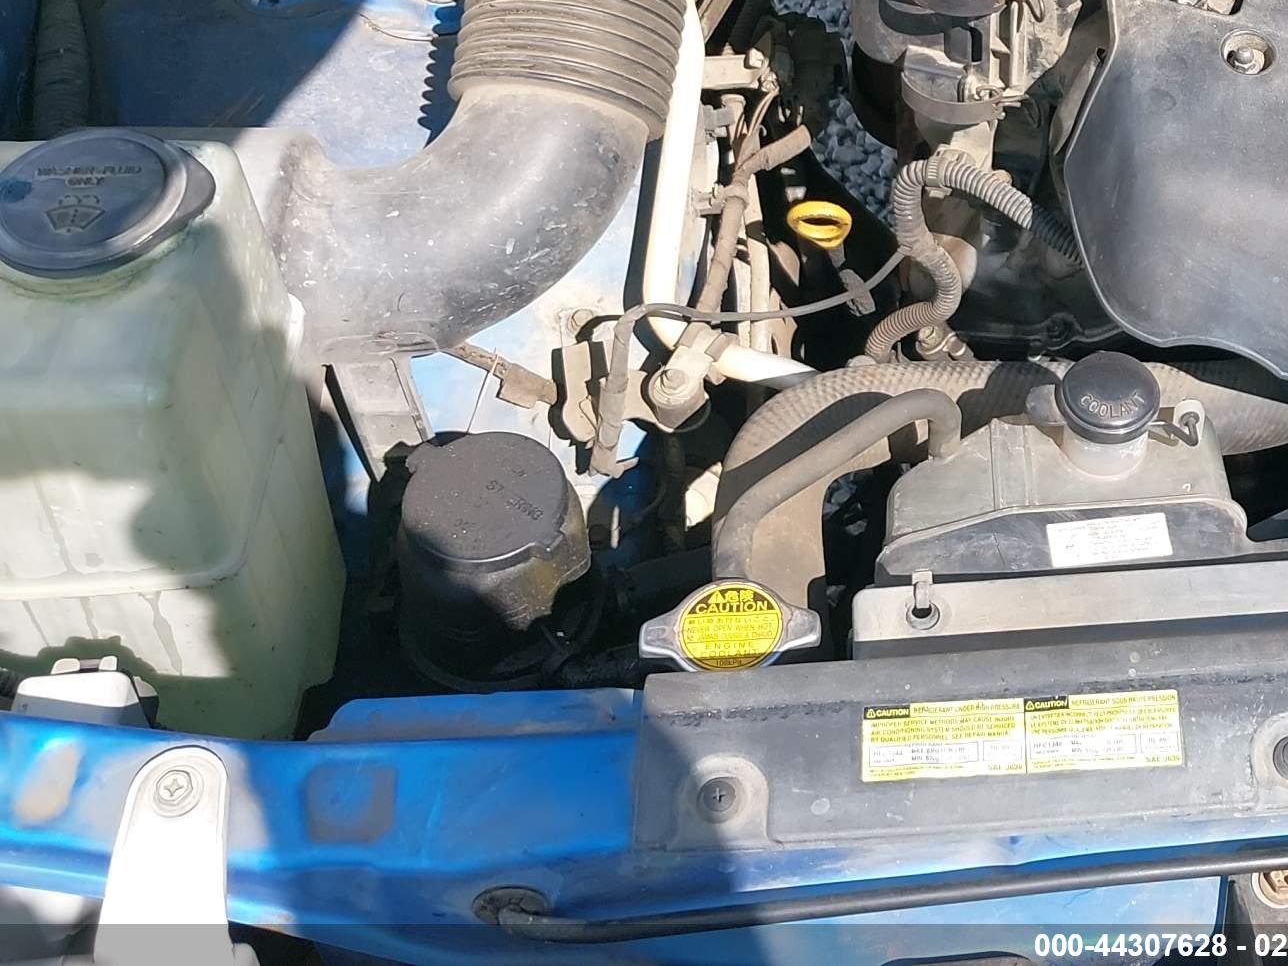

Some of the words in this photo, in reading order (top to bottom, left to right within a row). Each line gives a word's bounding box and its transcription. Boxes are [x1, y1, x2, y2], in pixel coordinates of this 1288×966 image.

[1080, 390, 1145, 418] COOLANT
[727, 589, 754, 602] 危険
[696, 600, 768, 613] CAUTION
[705, 641, 754, 650] ENGINE
[701, 649, 758, 657] COOLANT
[1035, 700, 1067, 710] CAUTION
[876, 708, 909, 718] CAUTION
